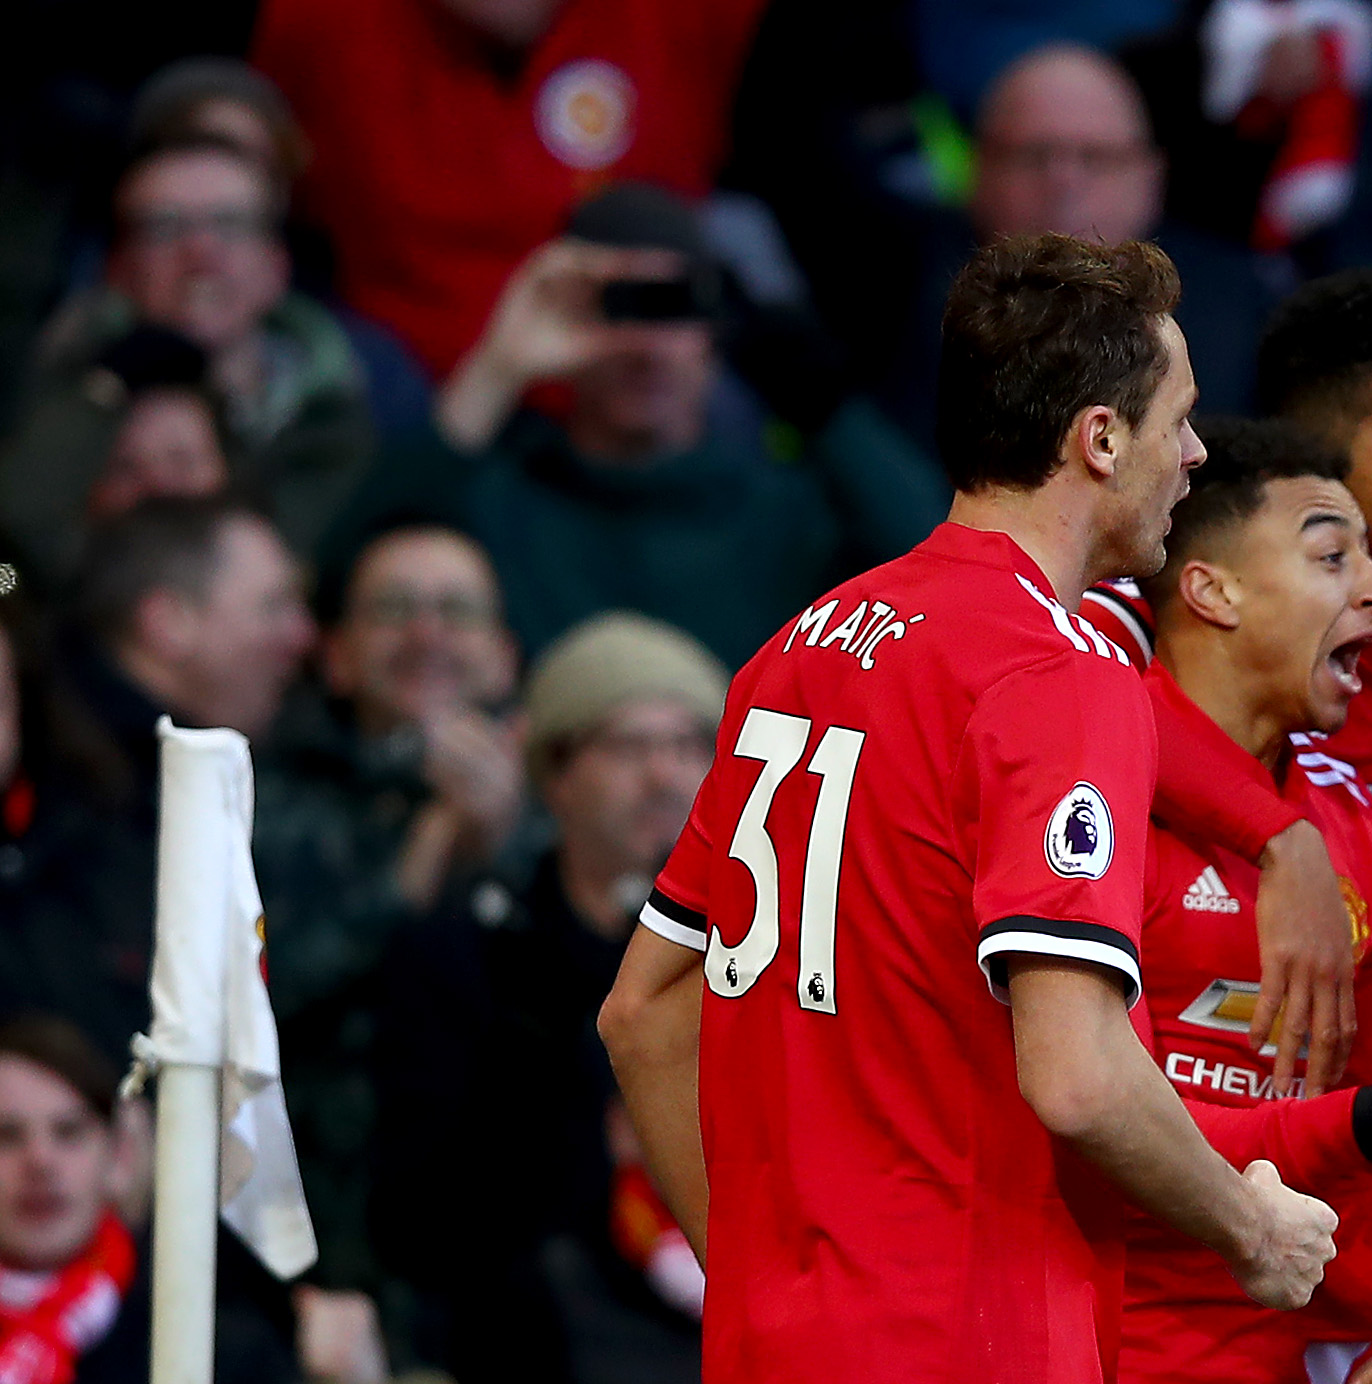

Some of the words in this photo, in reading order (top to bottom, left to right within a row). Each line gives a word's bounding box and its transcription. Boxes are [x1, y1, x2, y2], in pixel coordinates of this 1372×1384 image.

[782, 599, 926, 671] MATIĆ
[703, 707, 867, 1016] 31
[1182, 893, 1241, 914] adidas
